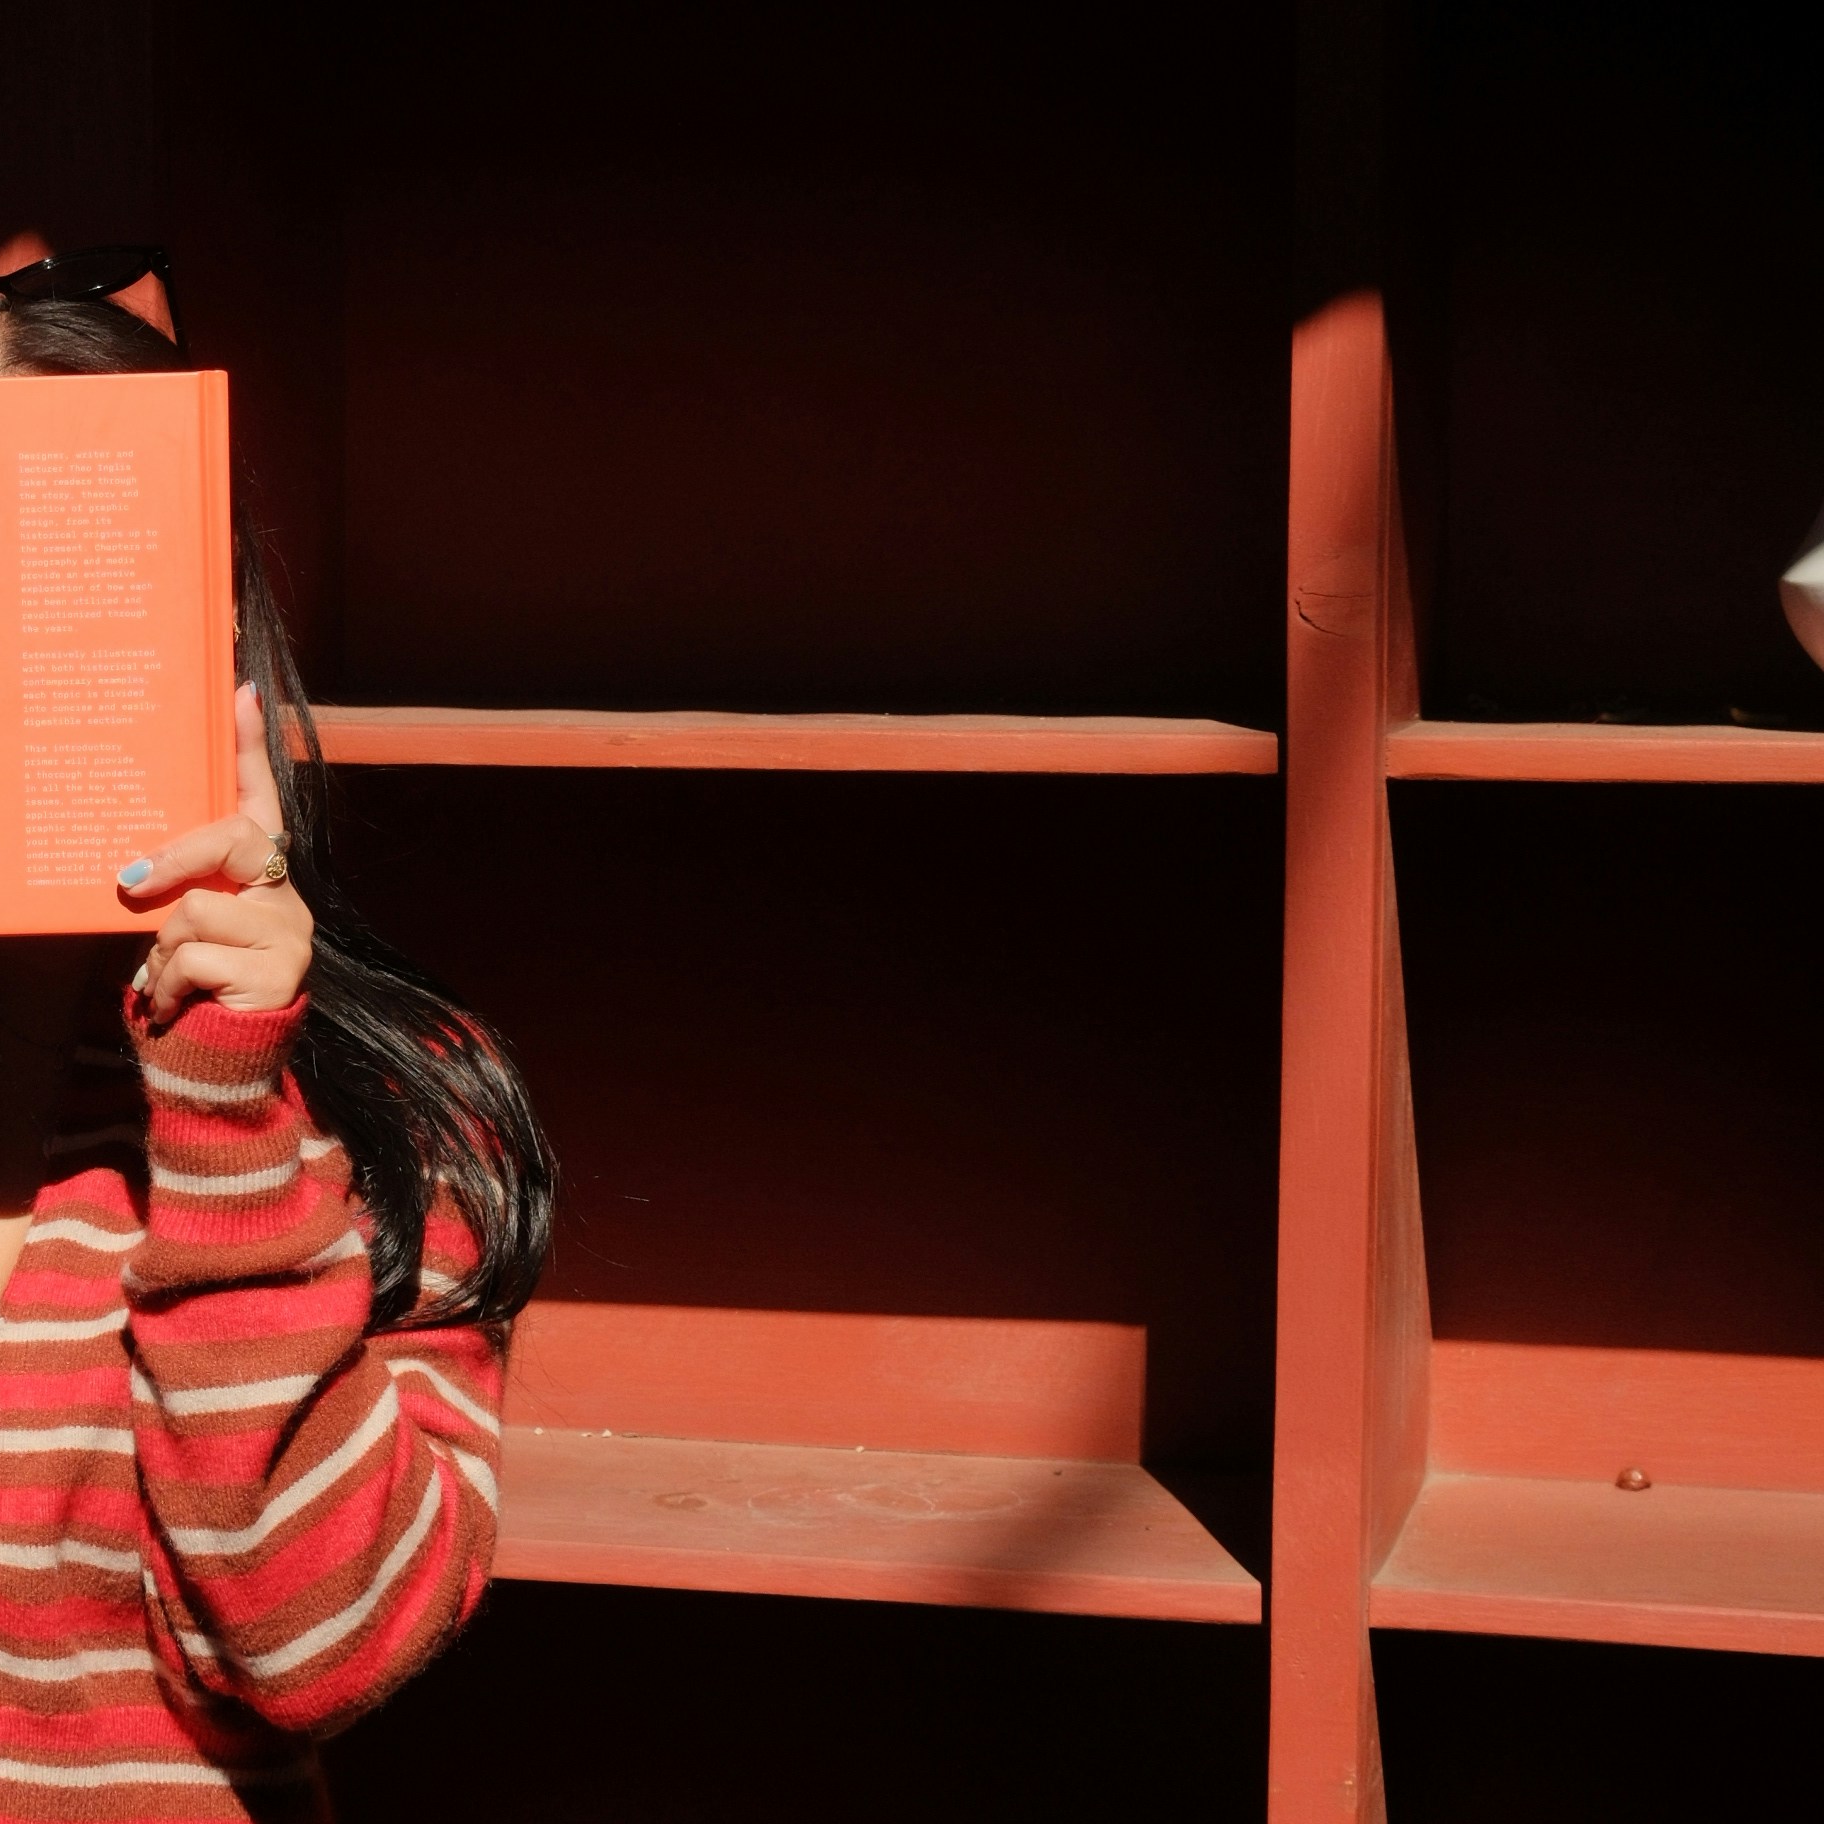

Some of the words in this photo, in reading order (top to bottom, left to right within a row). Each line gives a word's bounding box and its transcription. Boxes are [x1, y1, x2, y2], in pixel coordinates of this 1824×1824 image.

[76, 451, 111, 459] writer
[19, 465, 64, 473] lecturer
[97, 464, 131, 473] Inglis
[98, 477, 137, 486] through
[82, 491, 116, 500] theory
[122, 490, 139, 498] and
[19, 505, 66, 514] practice
[89, 504, 130, 513] graphic
[20, 531, 78, 539] historical
[83, 530, 124, 539] origins
[21, 545, 38, 553] the
[95, 543, 141, 552] Chapters
[21, 558, 78, 567] typography
[21, 571, 61, 580] provide
[84, 570, 136, 578] extensive
[21, 584, 84, 594] exploration
[107, 583, 124, 591] how
[21, 598, 39, 606] has
[73, 597, 119, 605] utilized
[125, 596, 142, 604] and
[21, 611, 102, 619] revolutionized
[108, 610, 148, 619] through
[22, 651, 86, 660] Extensively
[91, 650, 155, 658] illustrated
[51, 664, 74, 672] both
[80, 663, 138, 671] historical
[23, 678, 92, 687] contemporary
[52, 691, 81, 700] topic
[52, 704, 92, 712] concise
[24, 718, 81, 727] digestible
[53, 744, 122, 753] introductory
[24, 758, 59, 767] primer
[65, 757, 88, 765] will
[94, 757, 135, 765] provide
[36, 771, 82, 780] thorough
[88, 784, 105, 792] key
[130, 796, 147, 804] and
[25, 811, 95, 820] applications
[101, 810, 165, 819] surrounding
[25, 824, 65, 833] graphic
[117, 823, 168, 832] expanding
[55, 837, 107, 846] knowledge
[113, 836, 130, 844] and
[26, 850, 102, 860] understanding
[125, 849, 142, 857] the
[55, 864, 84, 872] world
